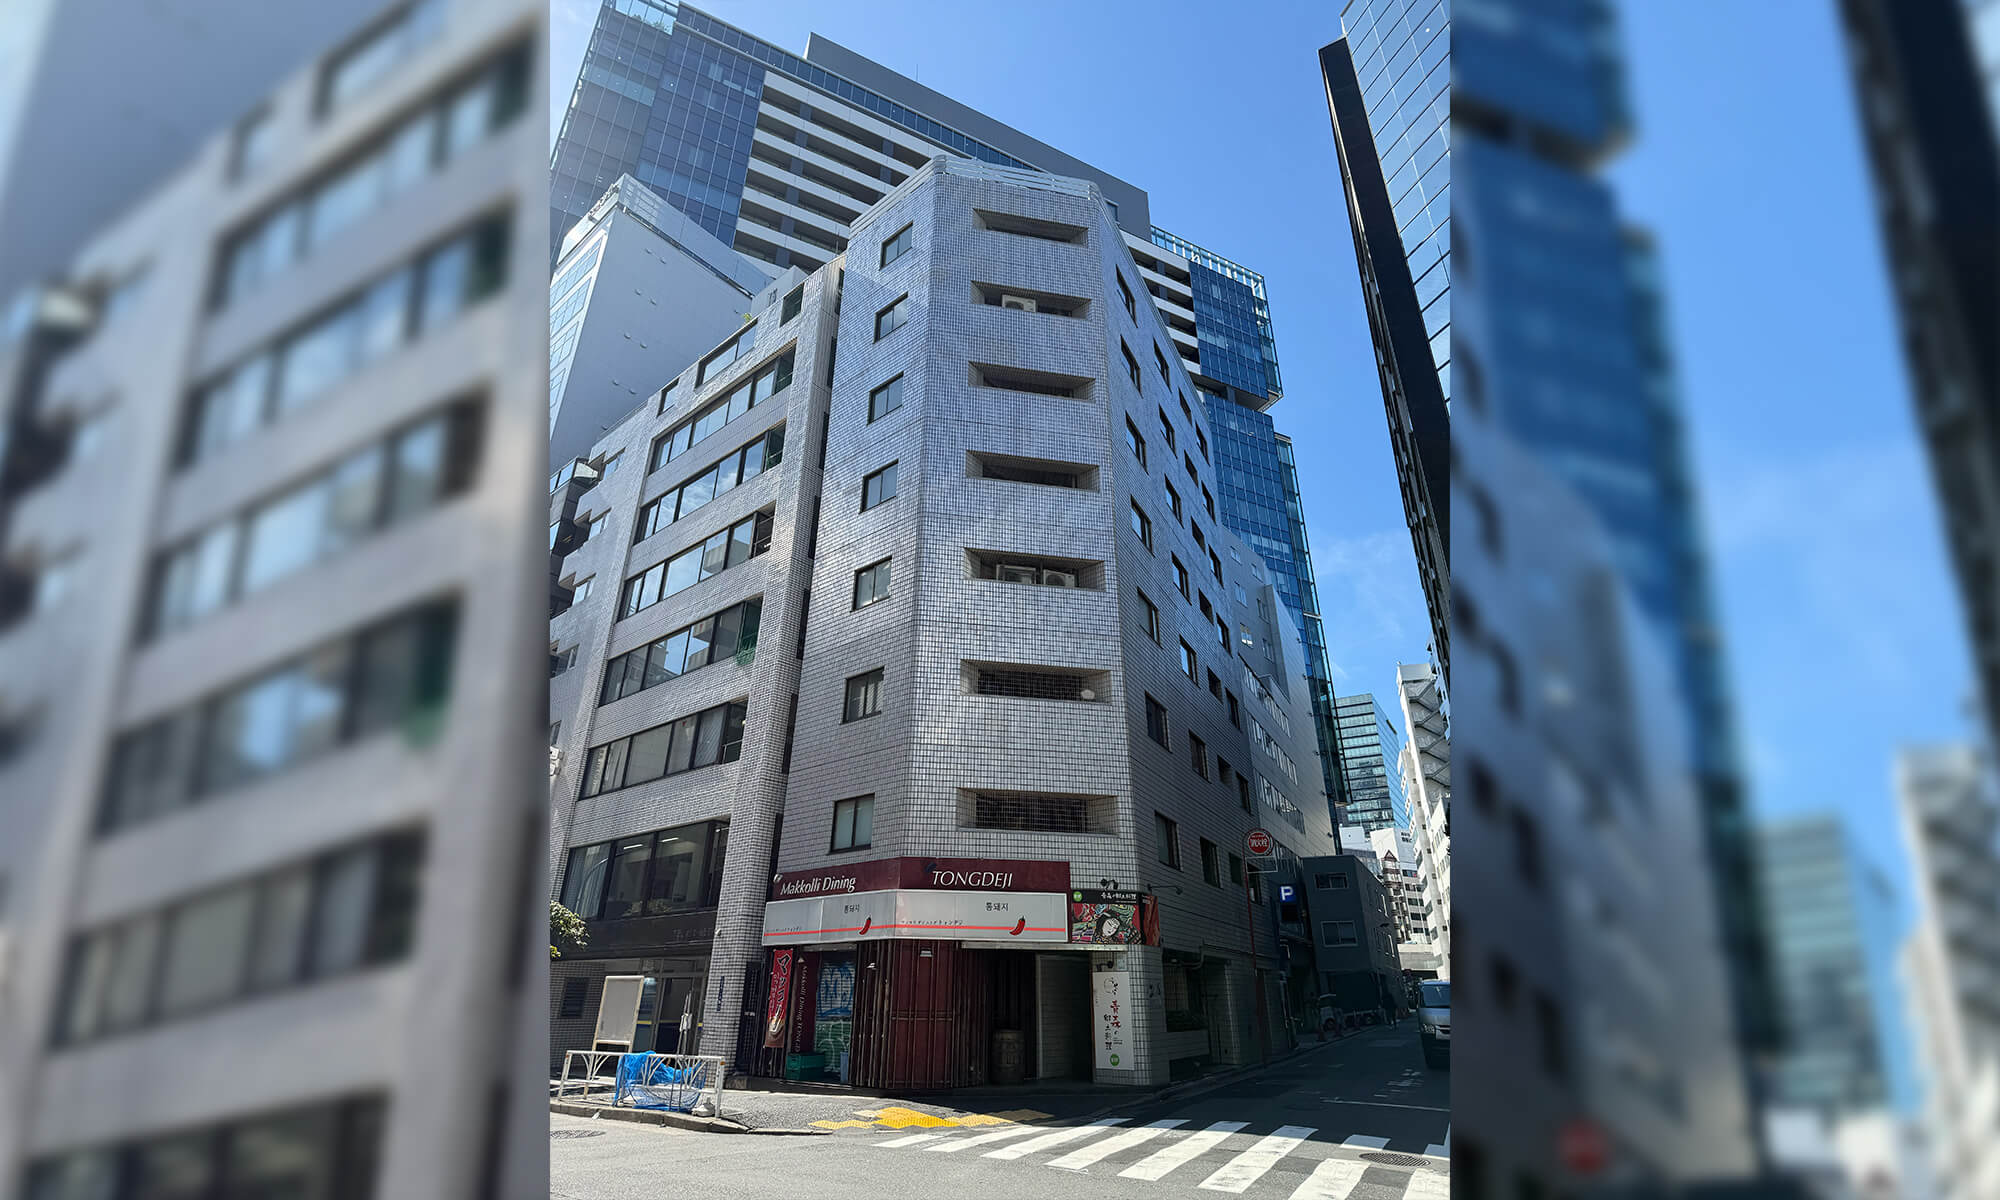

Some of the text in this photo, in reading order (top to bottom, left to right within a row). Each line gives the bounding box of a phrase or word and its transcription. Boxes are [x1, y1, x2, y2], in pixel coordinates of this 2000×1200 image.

[780, 874, 857, 896] Makkolli Dining
[932, 870, 1013, 888] TONGDEJI
[1281, 885, 1294, 901] P
